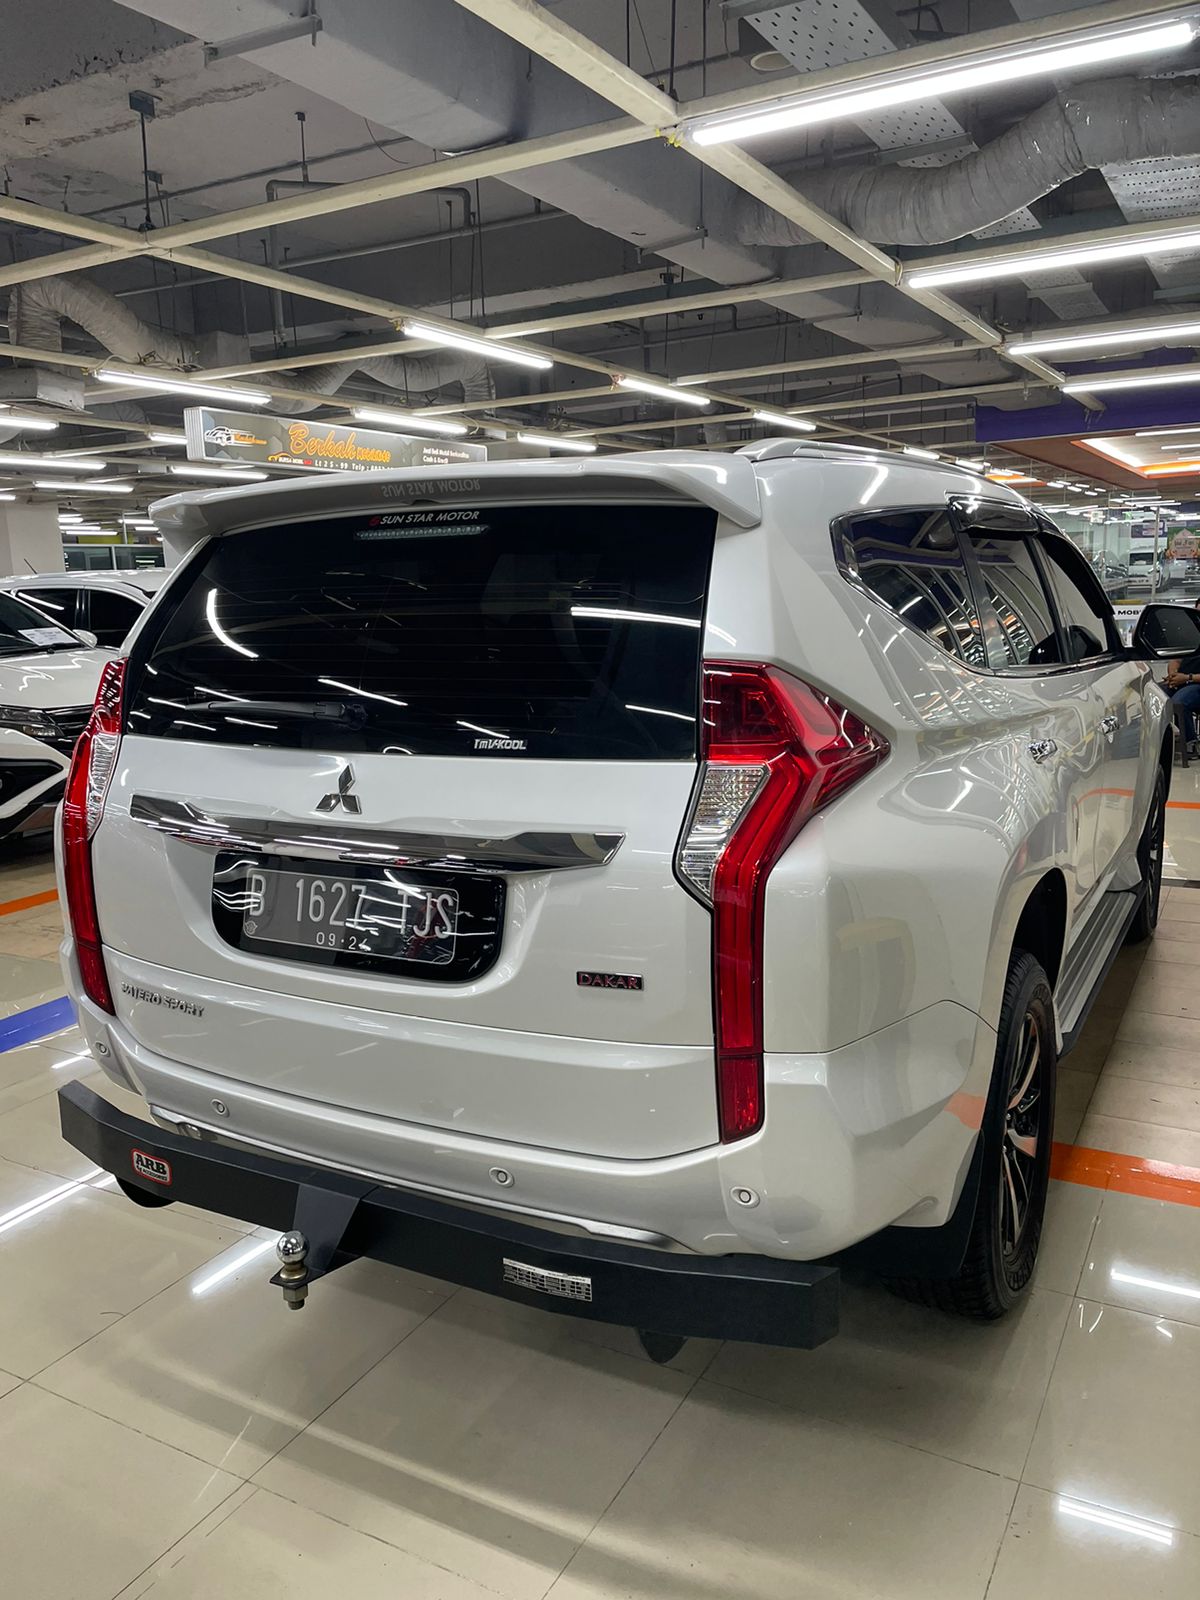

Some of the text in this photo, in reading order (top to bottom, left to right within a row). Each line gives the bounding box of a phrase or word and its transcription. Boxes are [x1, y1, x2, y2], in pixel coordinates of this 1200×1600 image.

[288, 422, 356, 459] Berkah
[380, 511, 480, 525] SUN STAR MOTOR
[248, 874, 454, 939] B 1627 TJS
[578, 972, 639, 989] DAKAR
[121, 982, 205, 1018] PAJERO SPORT
[135, 1153, 167, 1175] ARB
